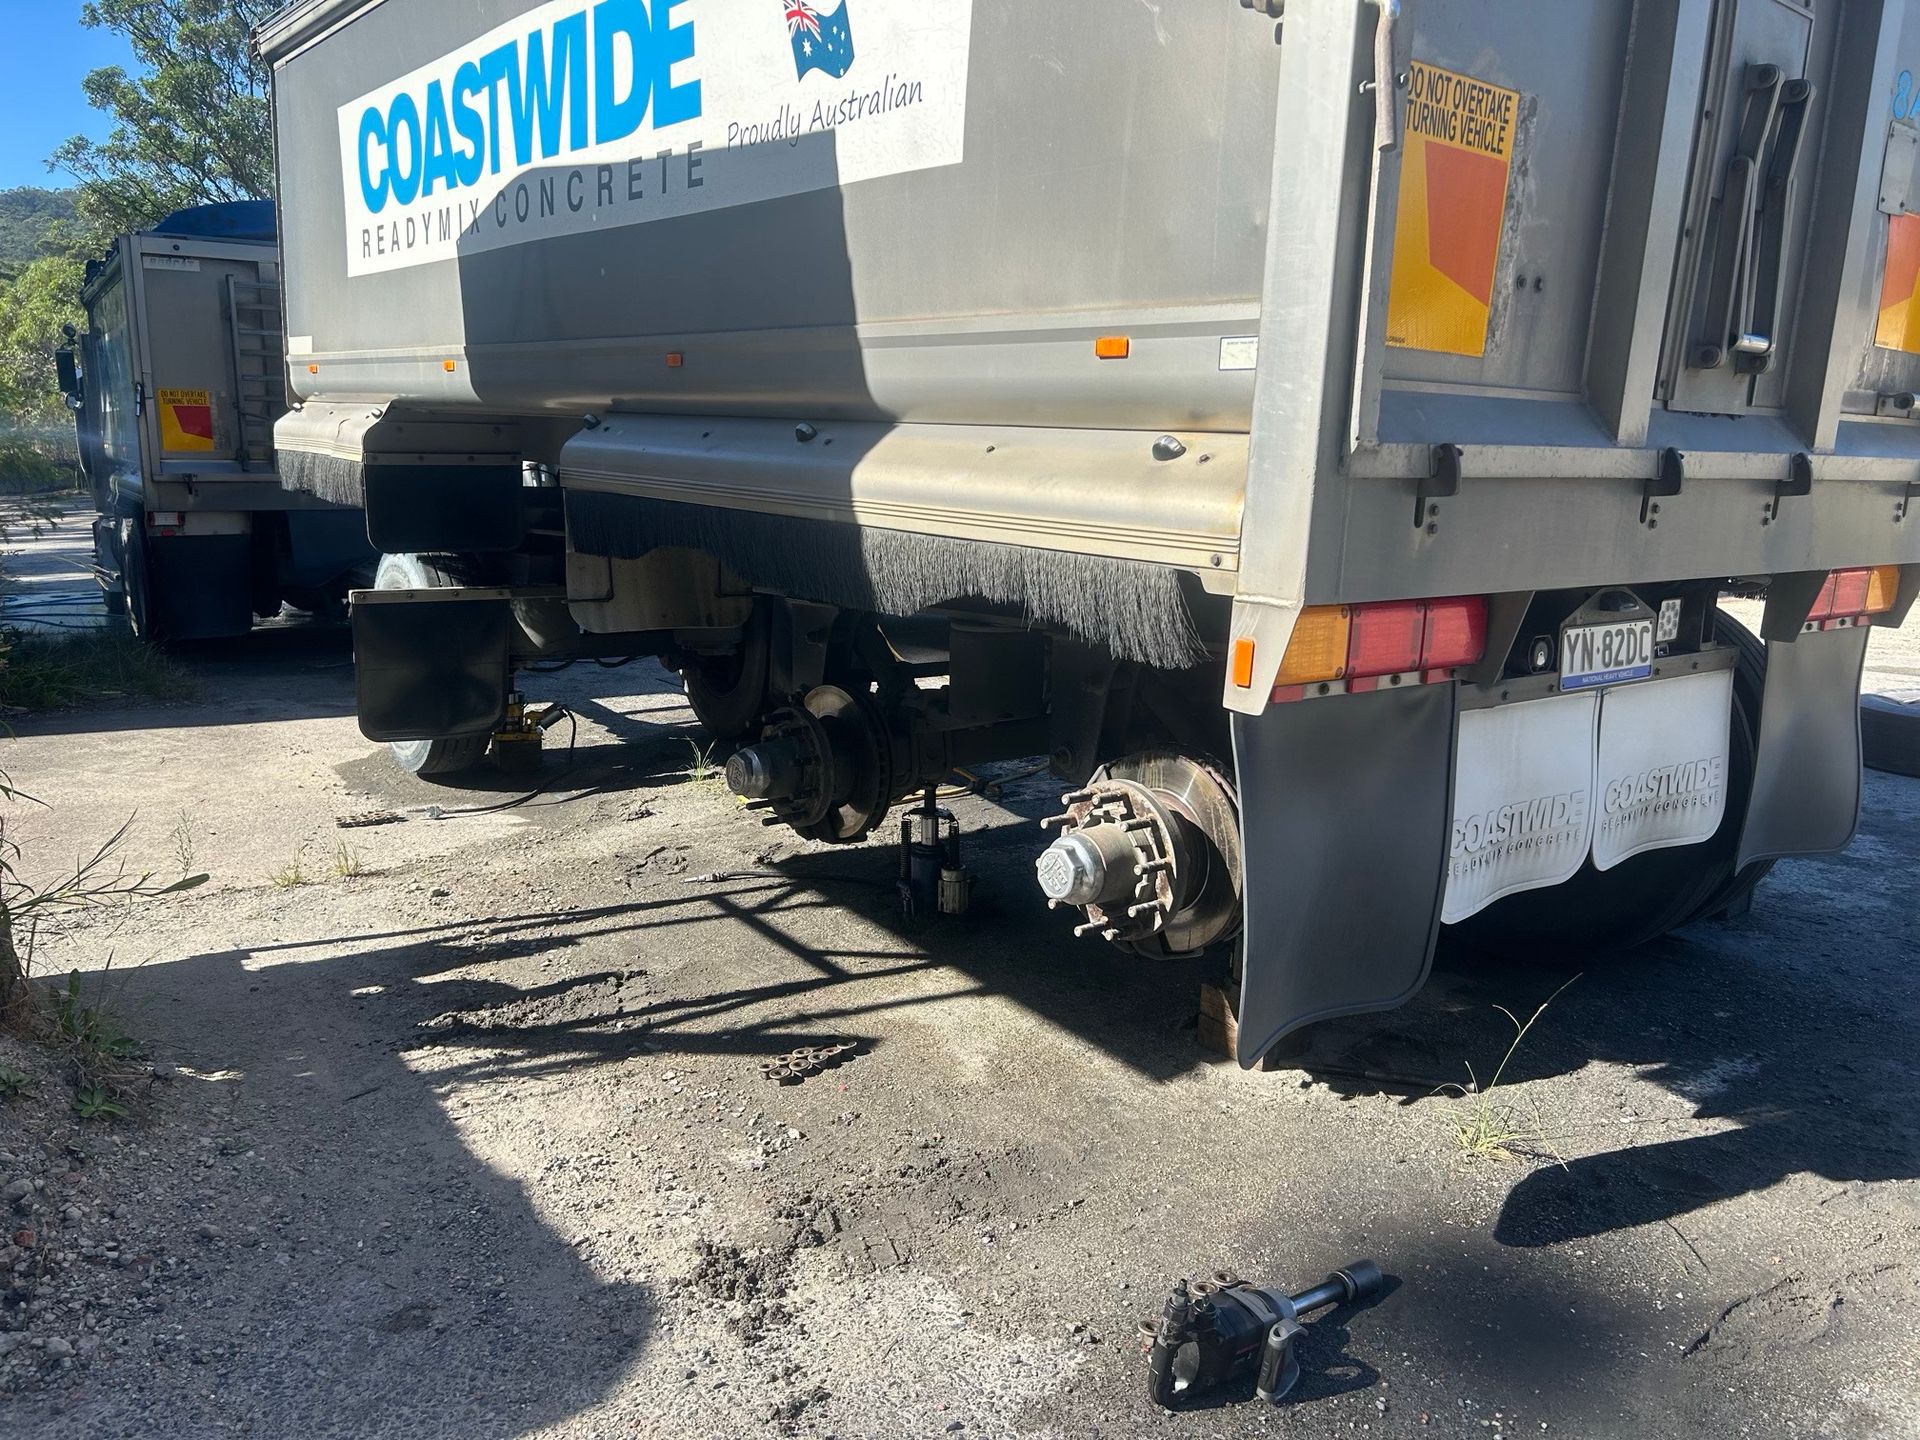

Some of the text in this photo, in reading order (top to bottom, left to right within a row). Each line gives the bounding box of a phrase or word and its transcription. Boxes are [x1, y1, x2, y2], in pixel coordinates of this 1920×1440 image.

[358, 0, 702, 214] COASTWIDE
[728, 73, 923, 152] Proudly Australian
[1426, 70, 1452, 106] NOT
[1453, 80, 1512, 125] OVERTAKE
[1407, 99, 1506, 155] TURNING VEHICLE
[362, 140, 704, 258] READYMIX CONCRETE
[169, 390, 179, 398] NOT
[180, 390, 207, 398] OVERTAKE
[1604, 756, 1720, 814] COASTWIDE
[1654, 791, 1719, 812] CONCRETE
[1448, 829, 1581, 875] EADYMIX CONCRETE
